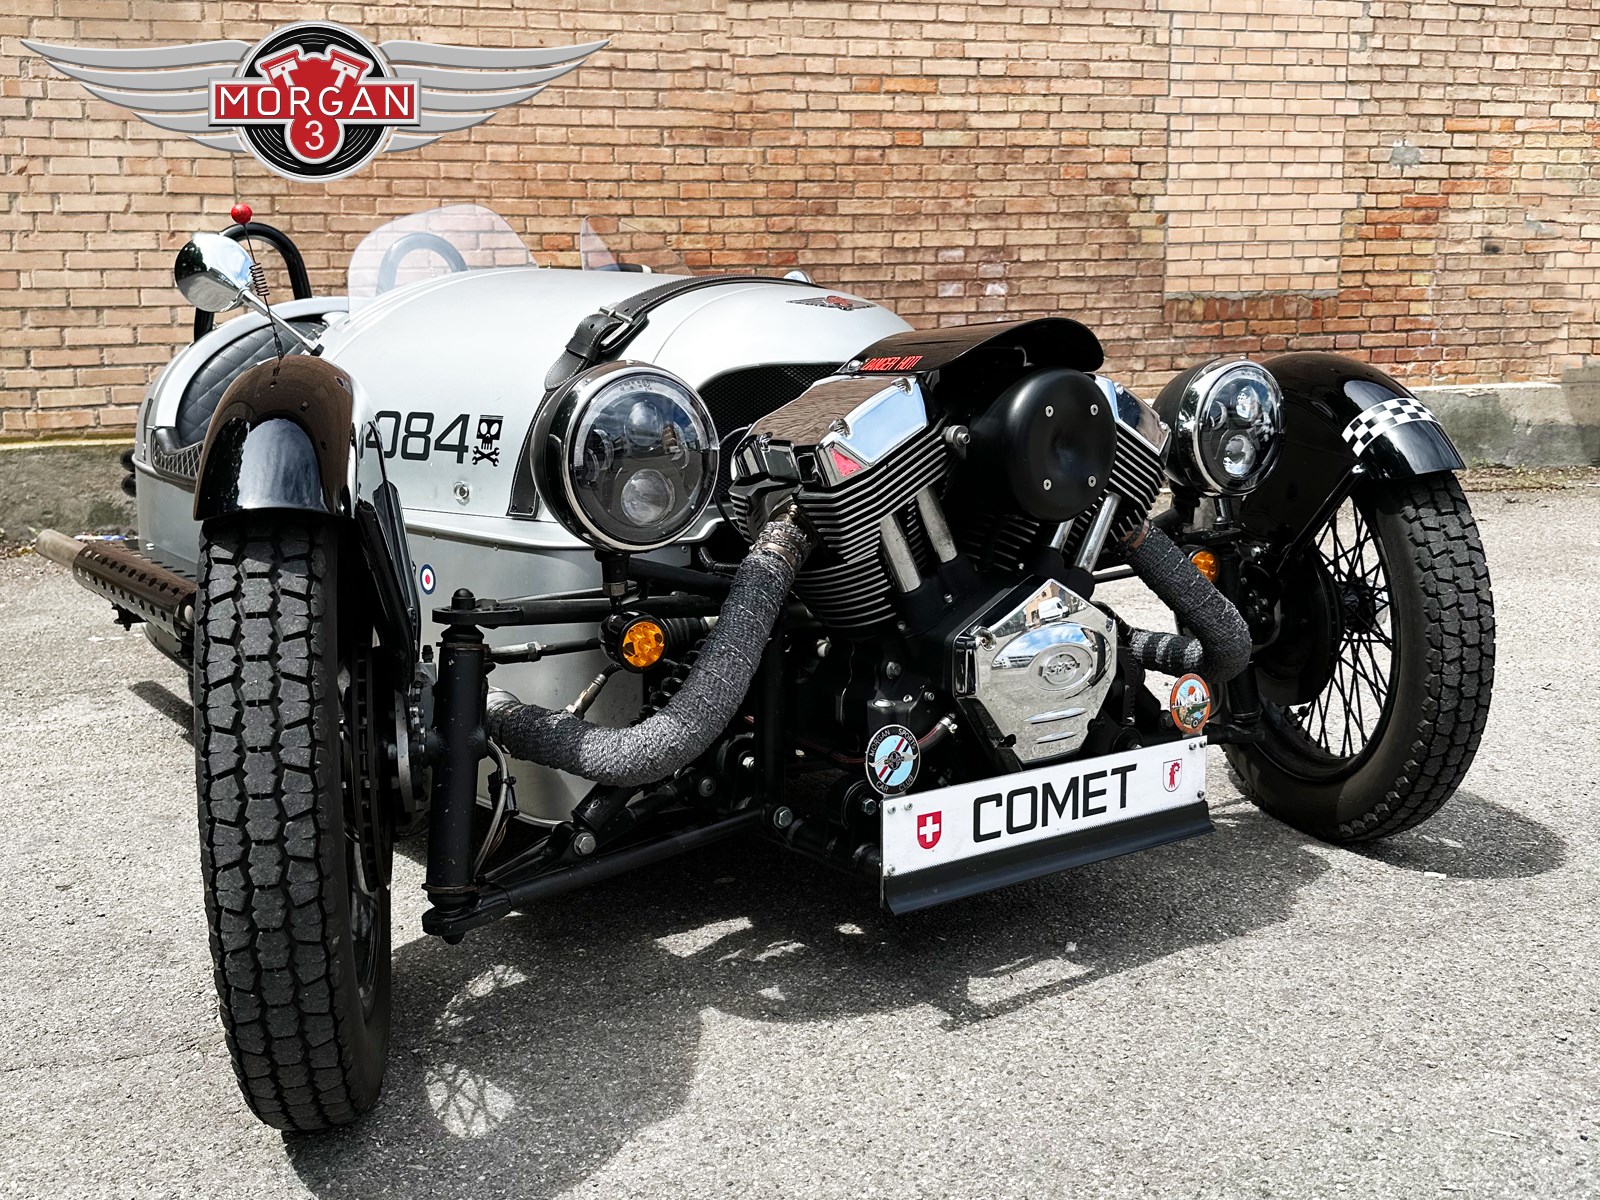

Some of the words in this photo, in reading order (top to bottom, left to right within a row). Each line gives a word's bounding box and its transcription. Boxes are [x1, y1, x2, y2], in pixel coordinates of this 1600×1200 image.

[861, 356, 900, 371] DANGER
[894, 355, 923, 370] HOT!
[869, 728, 891, 757] MORGAN
[898, 728, 917, 749] SPORTS
[875, 780, 889, 793] CAR
[898, 774, 914, 792] CLUB
[972, 763, 1137, 843] COMET
